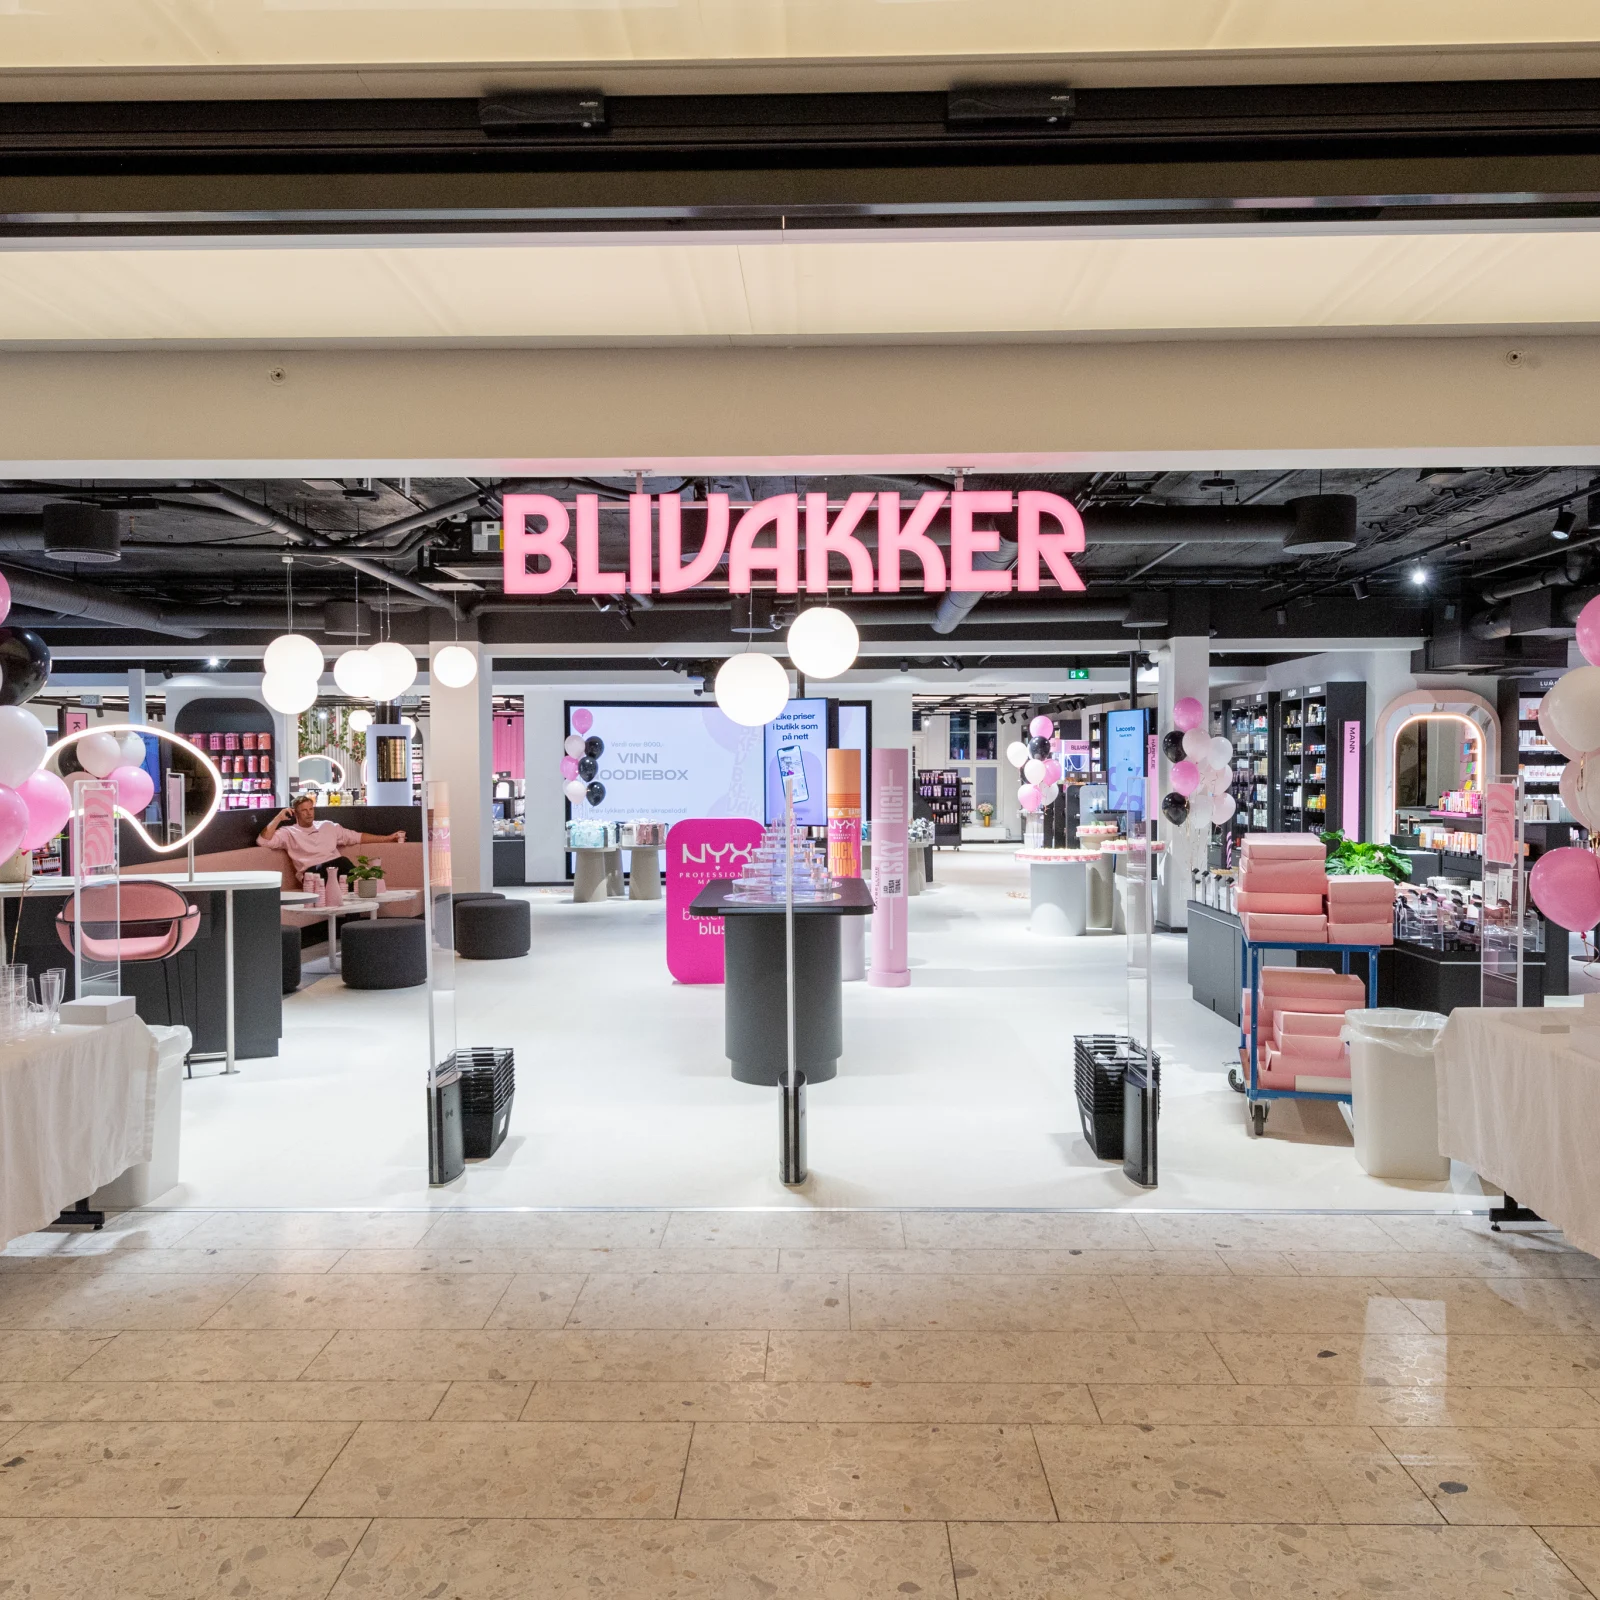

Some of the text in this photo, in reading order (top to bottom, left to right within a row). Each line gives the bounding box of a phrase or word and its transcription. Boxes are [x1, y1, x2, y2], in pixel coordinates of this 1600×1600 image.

[503, 491, 1086, 594] BLIVAKKER
[793, 713, 815, 721] priser
[782, 733, 792, 741] på
[617, 752, 658, 764] VINN
[596, 769, 689, 780] OODIEBOX
[879, 785, 904, 823] HIGH
[828, 819, 856, 830] NYX
[682, 843, 752, 864] NYX
[830, 841, 854, 859] DUCK
[878, 840, 904, 873] SKY
[828, 858, 857, 877] PLUMP
